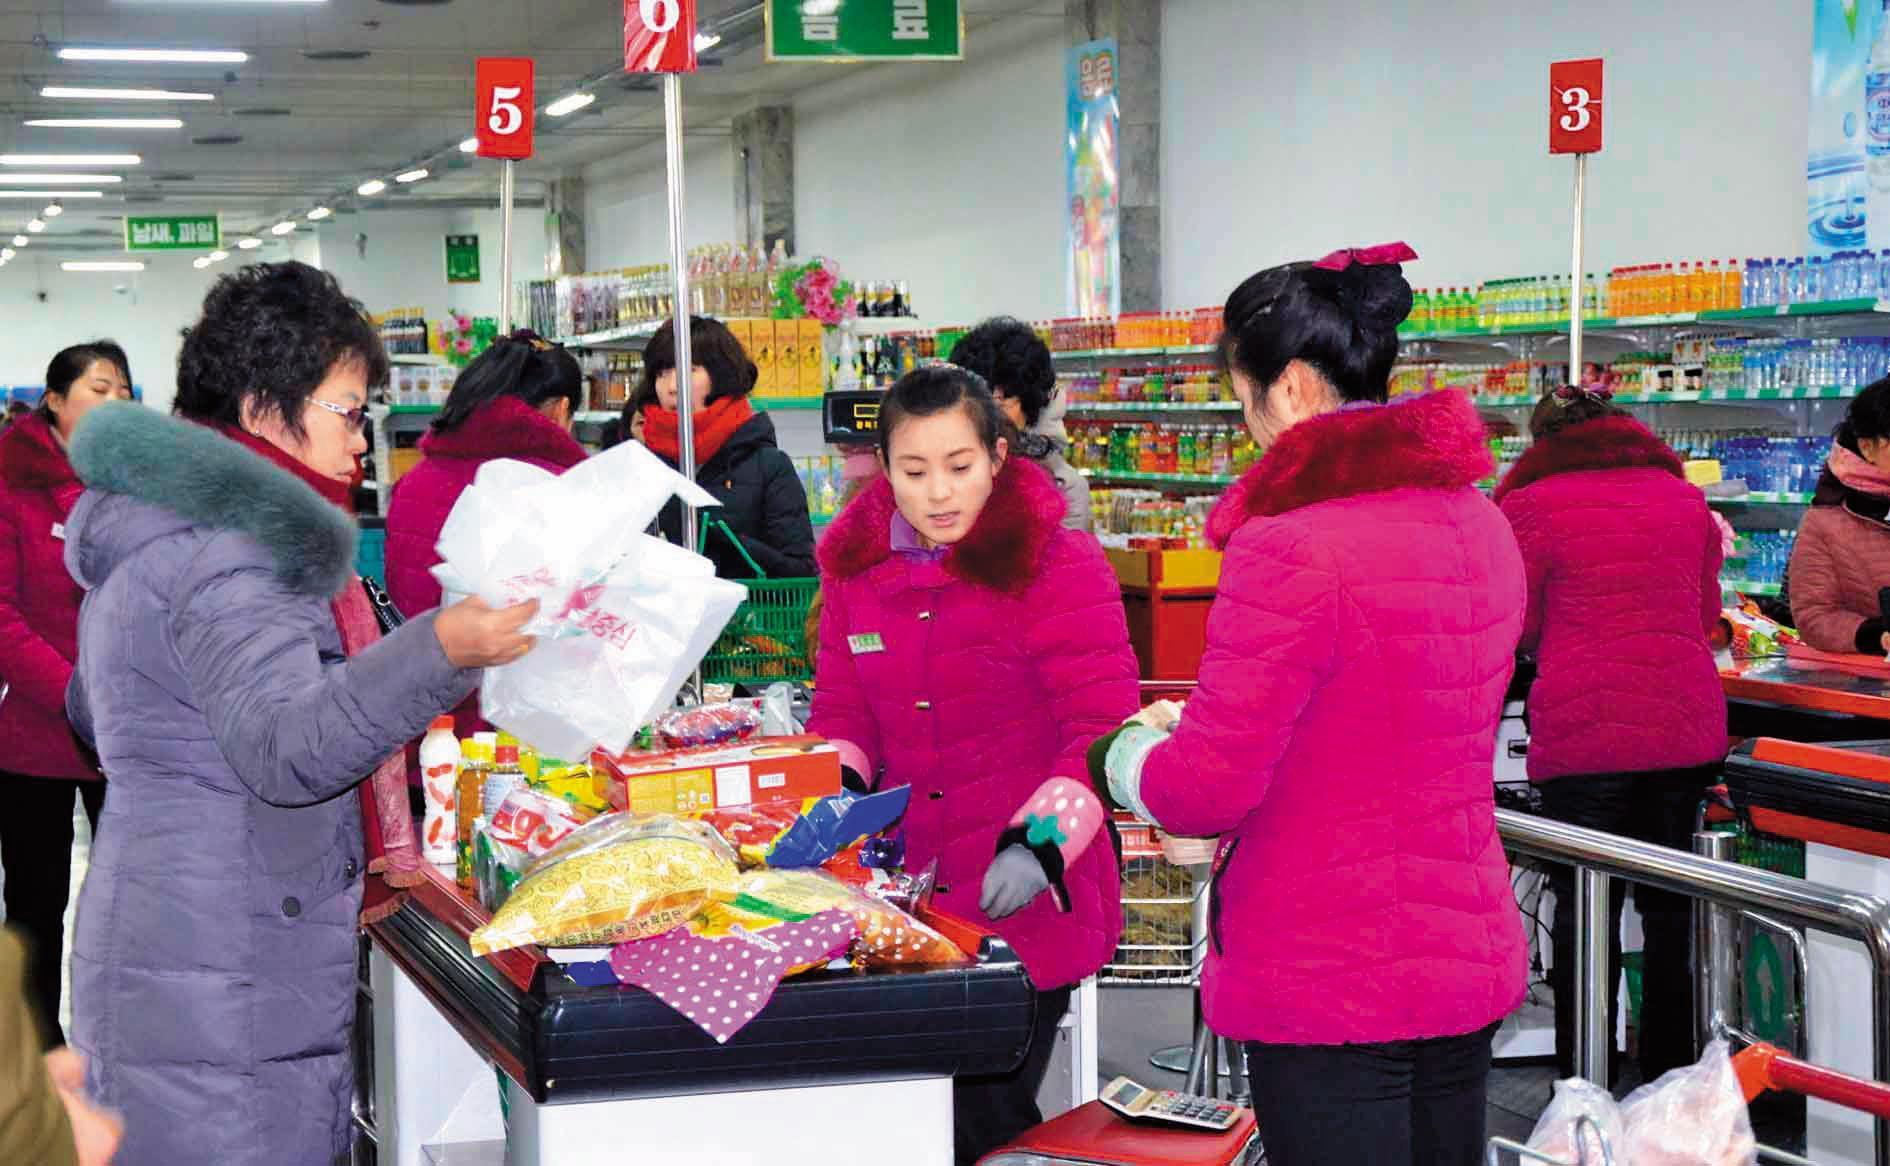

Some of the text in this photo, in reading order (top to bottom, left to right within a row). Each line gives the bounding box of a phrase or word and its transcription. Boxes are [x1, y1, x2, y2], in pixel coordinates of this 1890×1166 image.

[640, 0, 679, 32] 6
[489, 87, 522, 134] 5
[1560, 87, 1590, 131] 3
